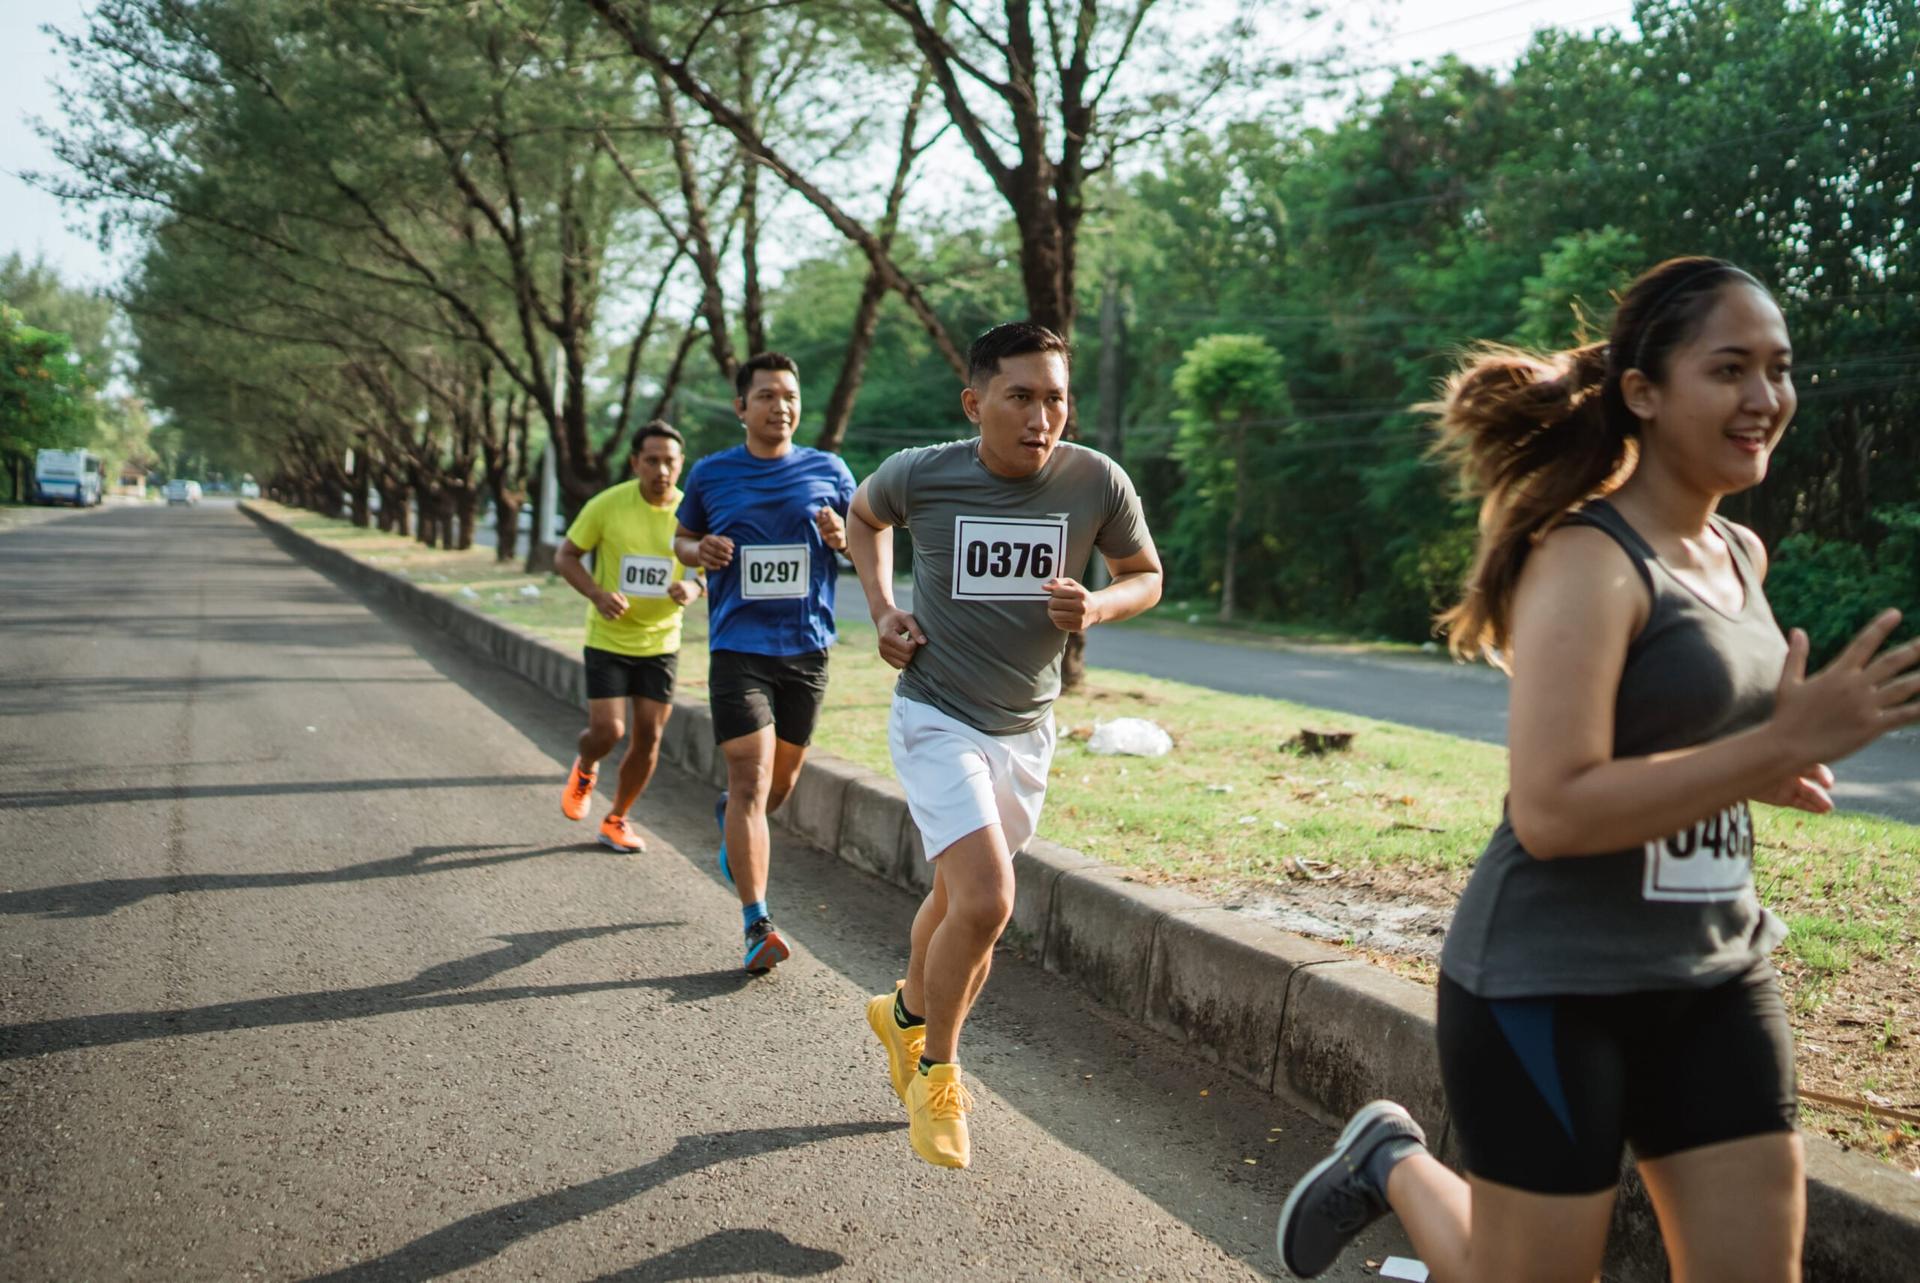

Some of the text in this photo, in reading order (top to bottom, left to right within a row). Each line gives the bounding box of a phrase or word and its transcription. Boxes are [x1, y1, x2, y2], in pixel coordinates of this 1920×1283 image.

[966, 540, 1053, 578] 0376
[626, 565, 667, 586] 0162
[750, 561, 799, 583] 0297
